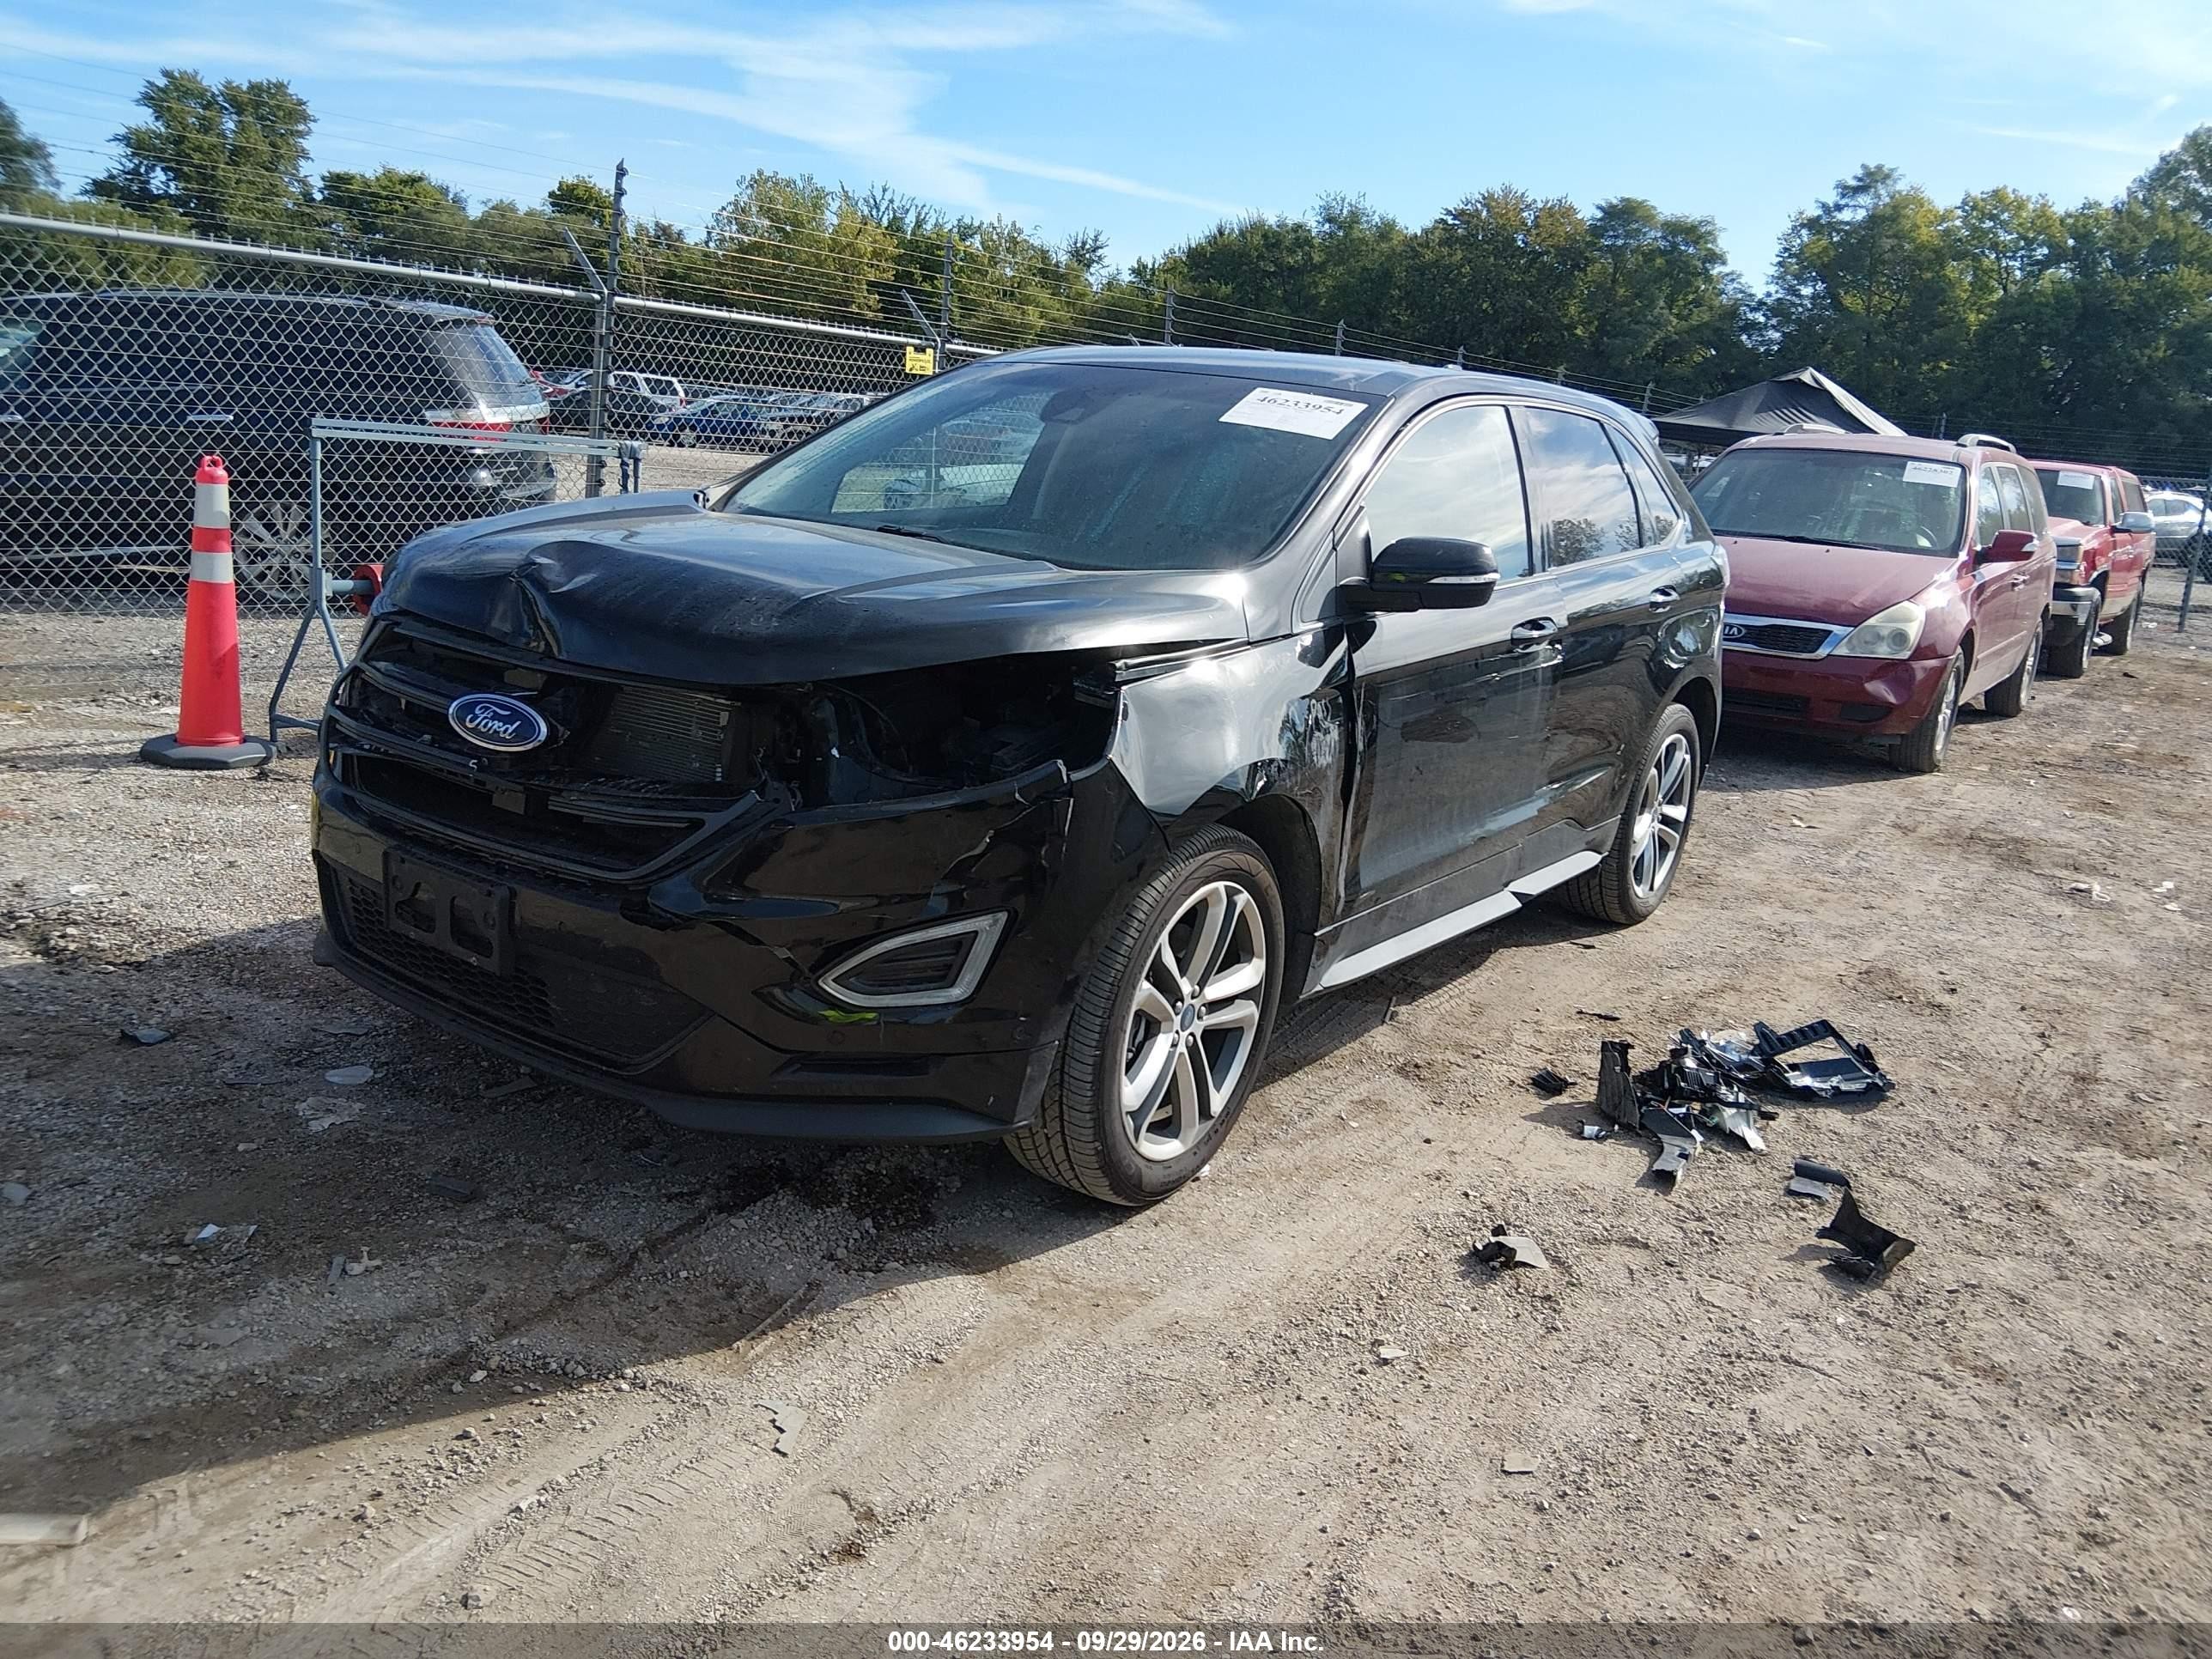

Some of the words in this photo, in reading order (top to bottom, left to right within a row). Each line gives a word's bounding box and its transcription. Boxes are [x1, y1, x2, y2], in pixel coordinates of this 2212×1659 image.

[1256, 396, 1345, 415] 46233954
[1723, 625, 1739, 635] IA
[465, 703, 521, 739] Ford
